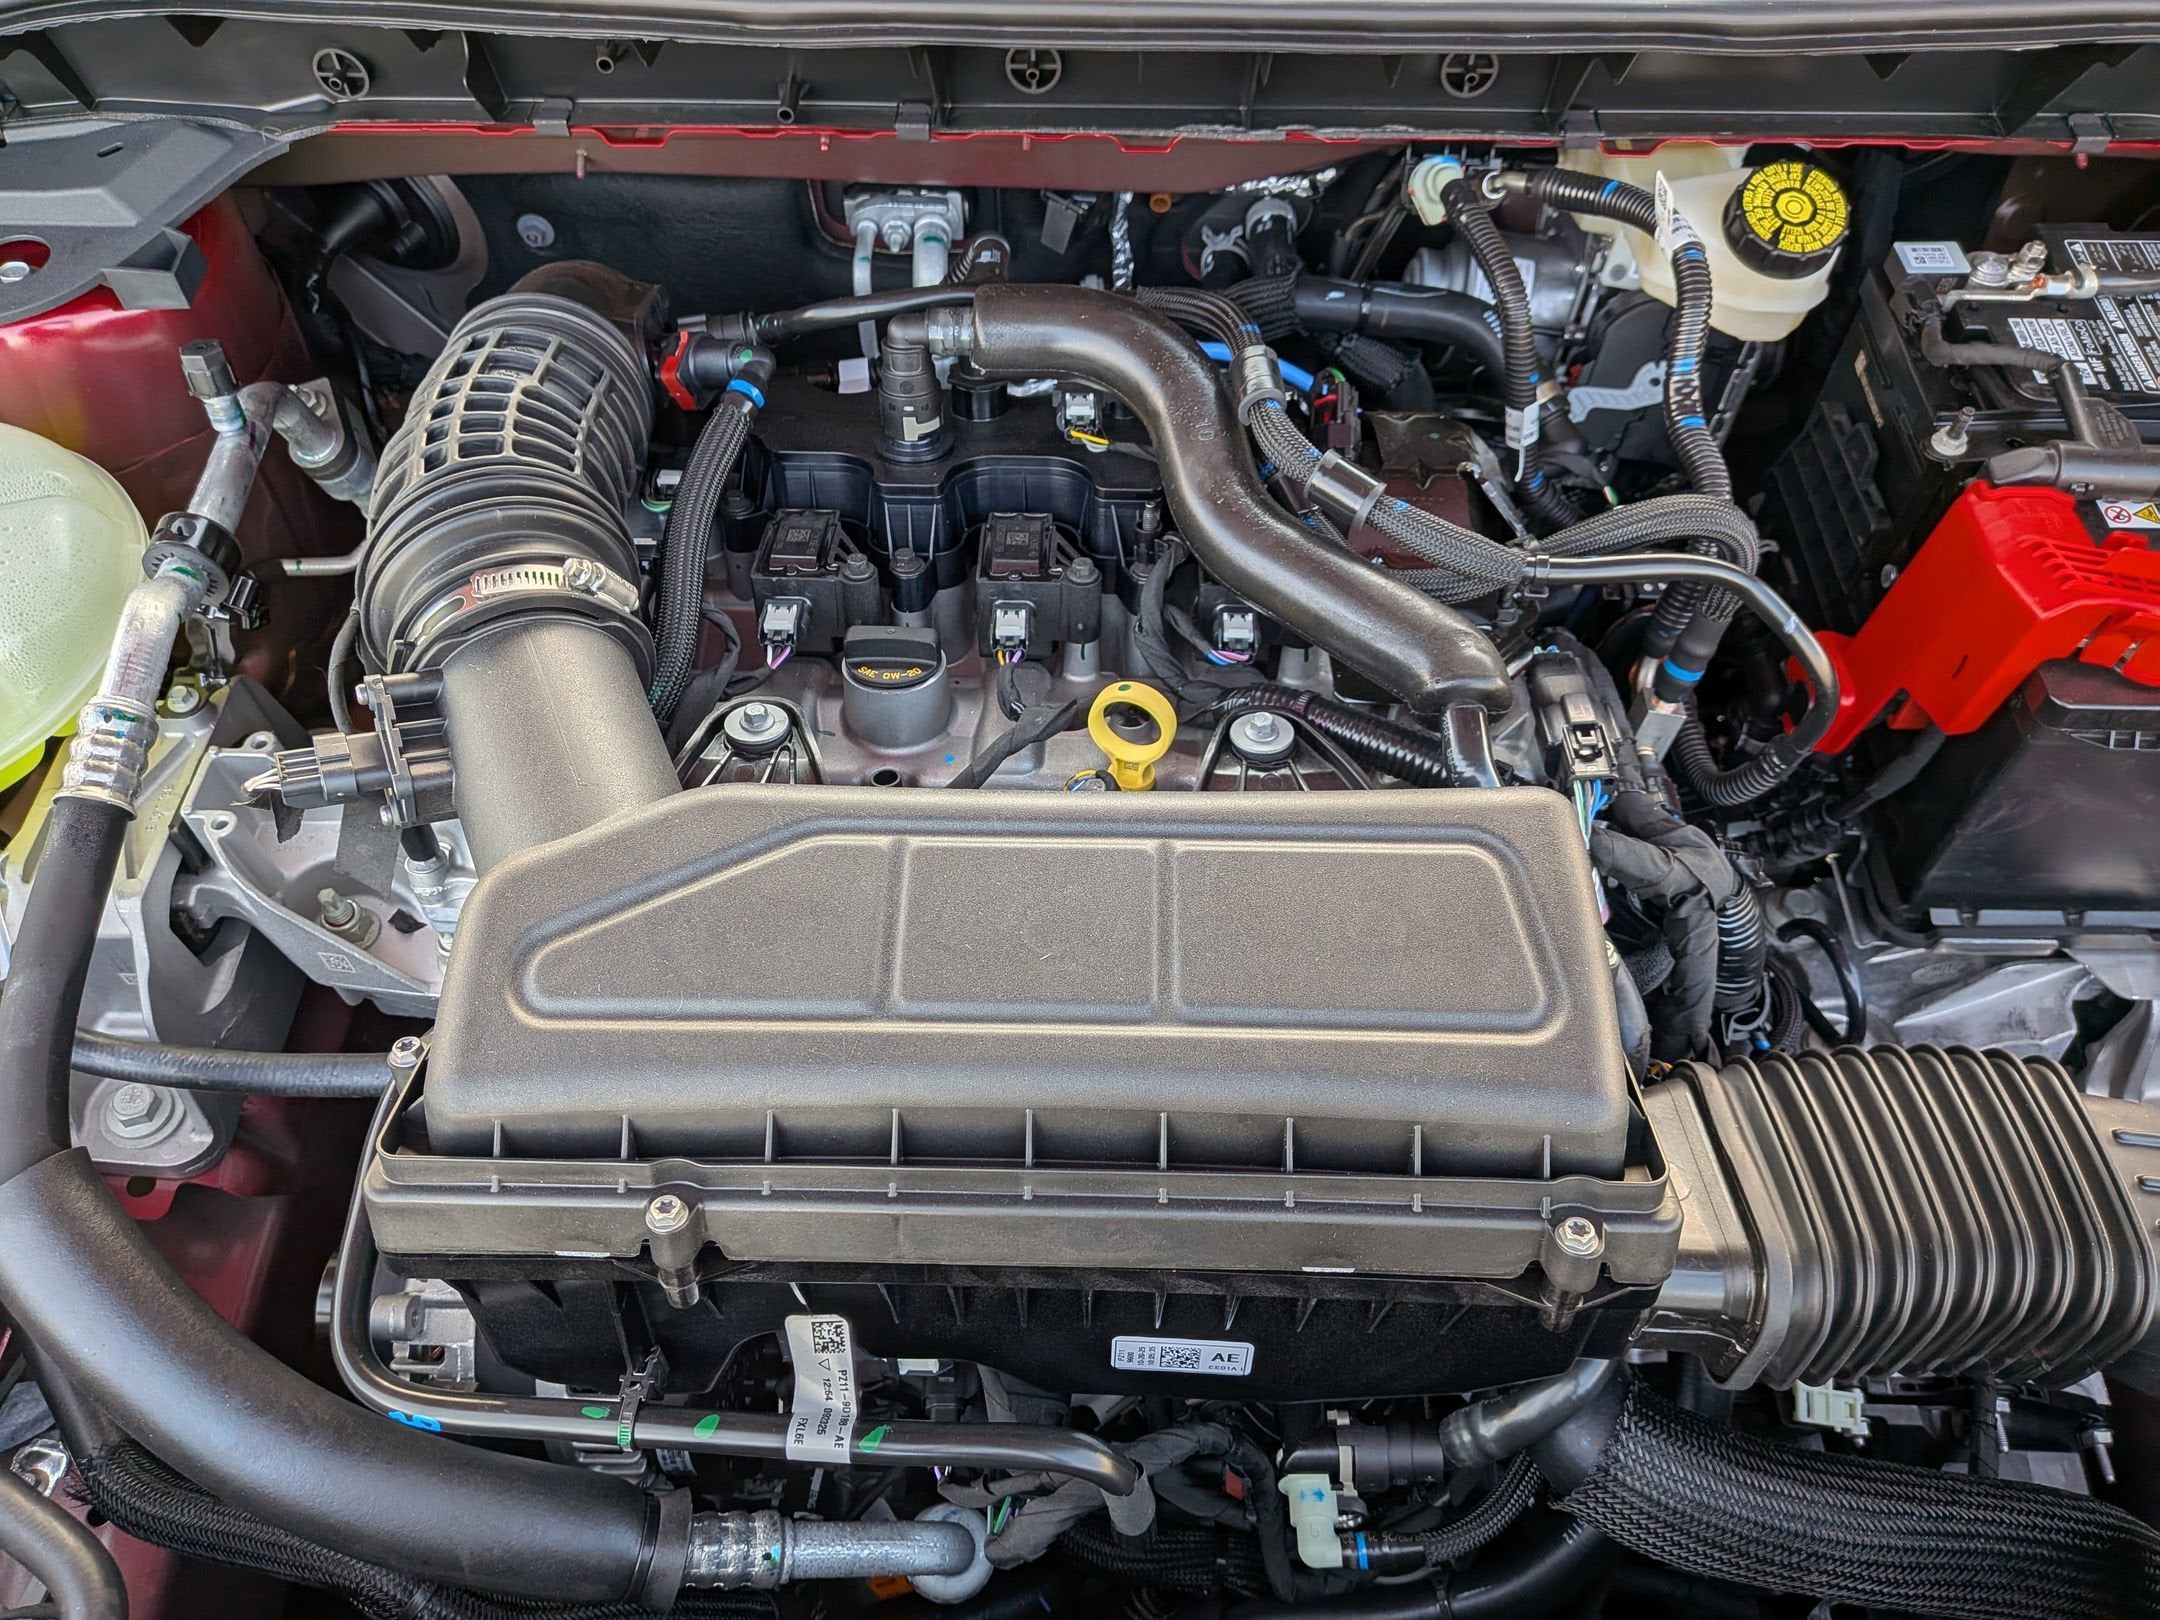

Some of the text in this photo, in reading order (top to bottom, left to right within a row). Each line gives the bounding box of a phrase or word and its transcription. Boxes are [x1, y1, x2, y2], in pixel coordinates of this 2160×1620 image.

[857, 666, 921, 680] SAE 0W-20
[1211, 1352, 1240, 1364] AE
